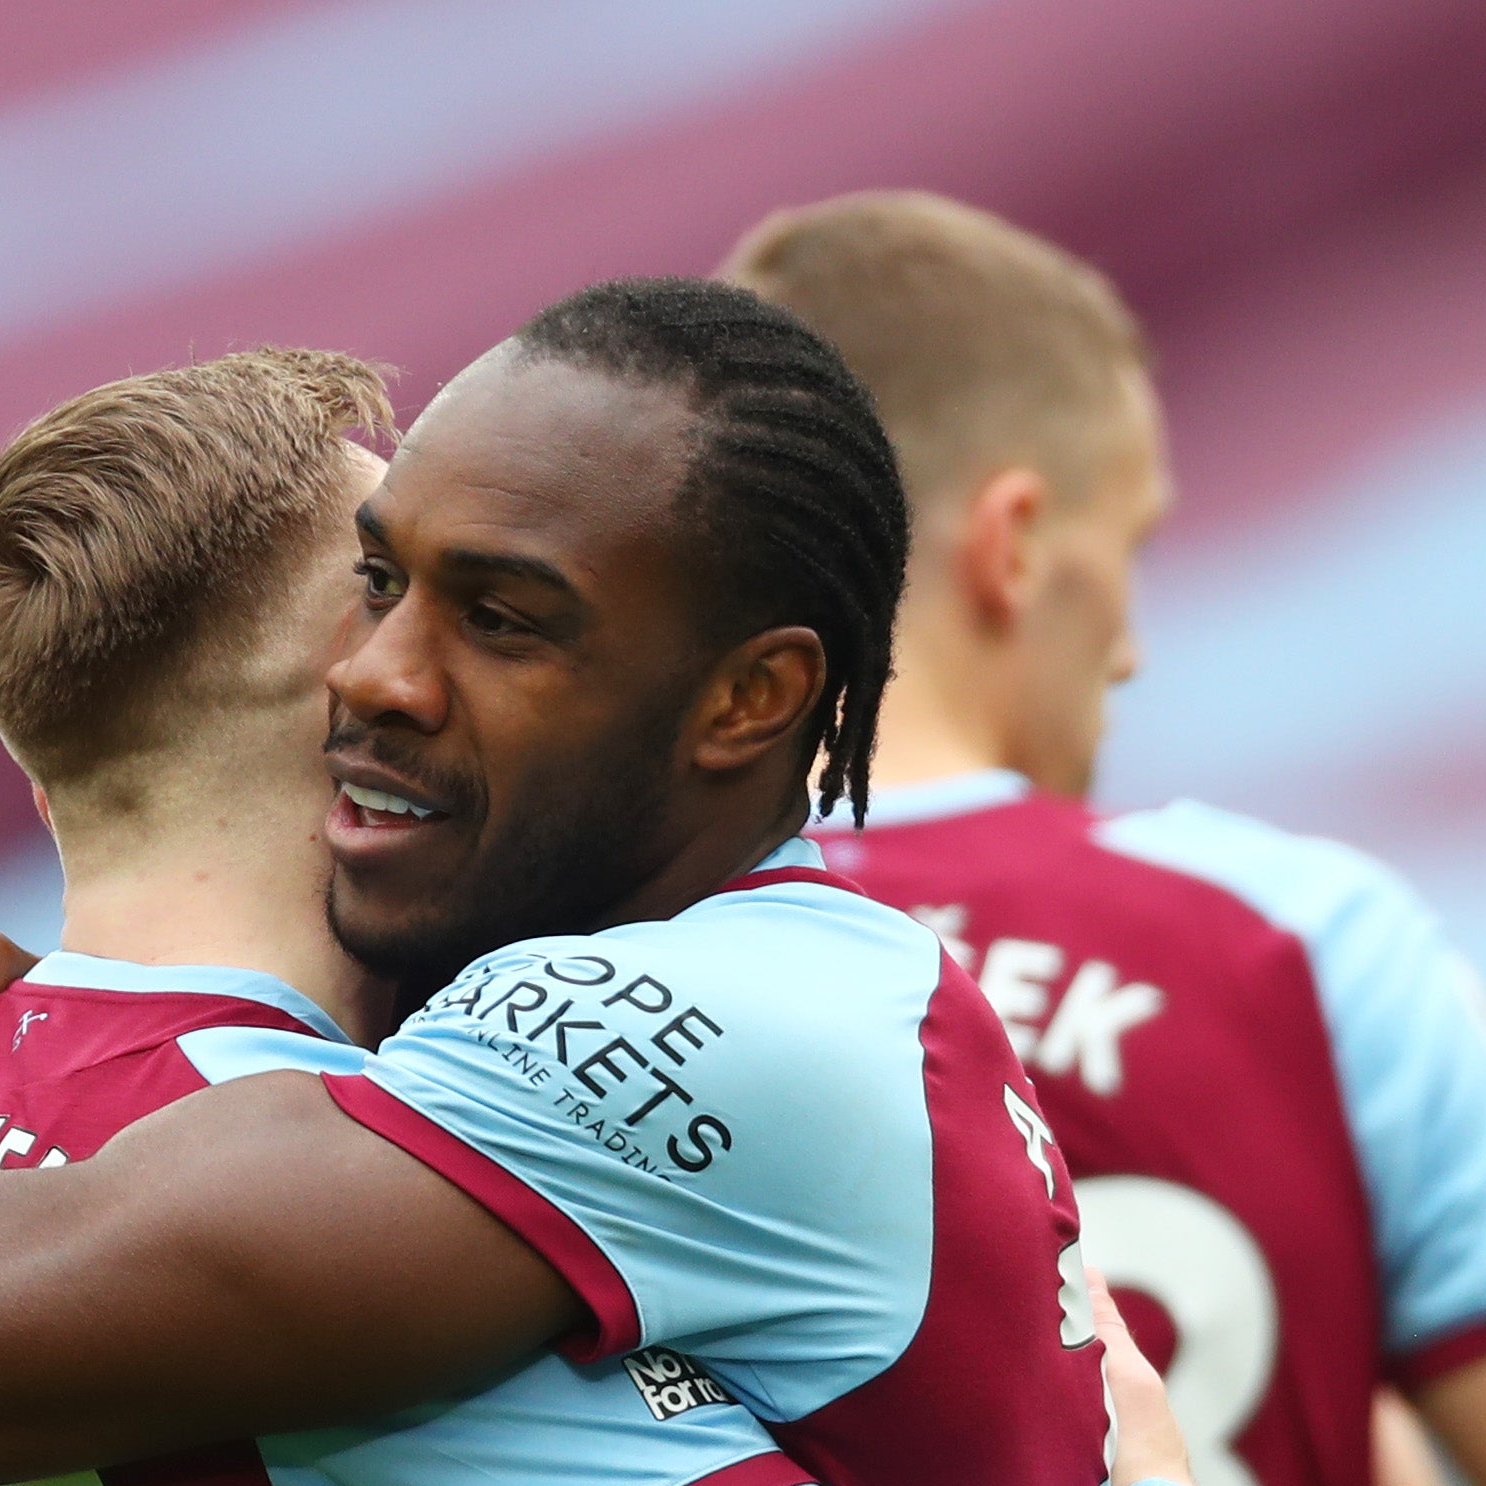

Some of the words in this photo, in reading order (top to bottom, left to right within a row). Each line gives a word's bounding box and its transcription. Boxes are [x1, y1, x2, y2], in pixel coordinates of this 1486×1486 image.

[424, 974, 732, 1174] ARKETS
[623, 1351, 682, 1391] No
[643, 1378, 697, 1421] for
